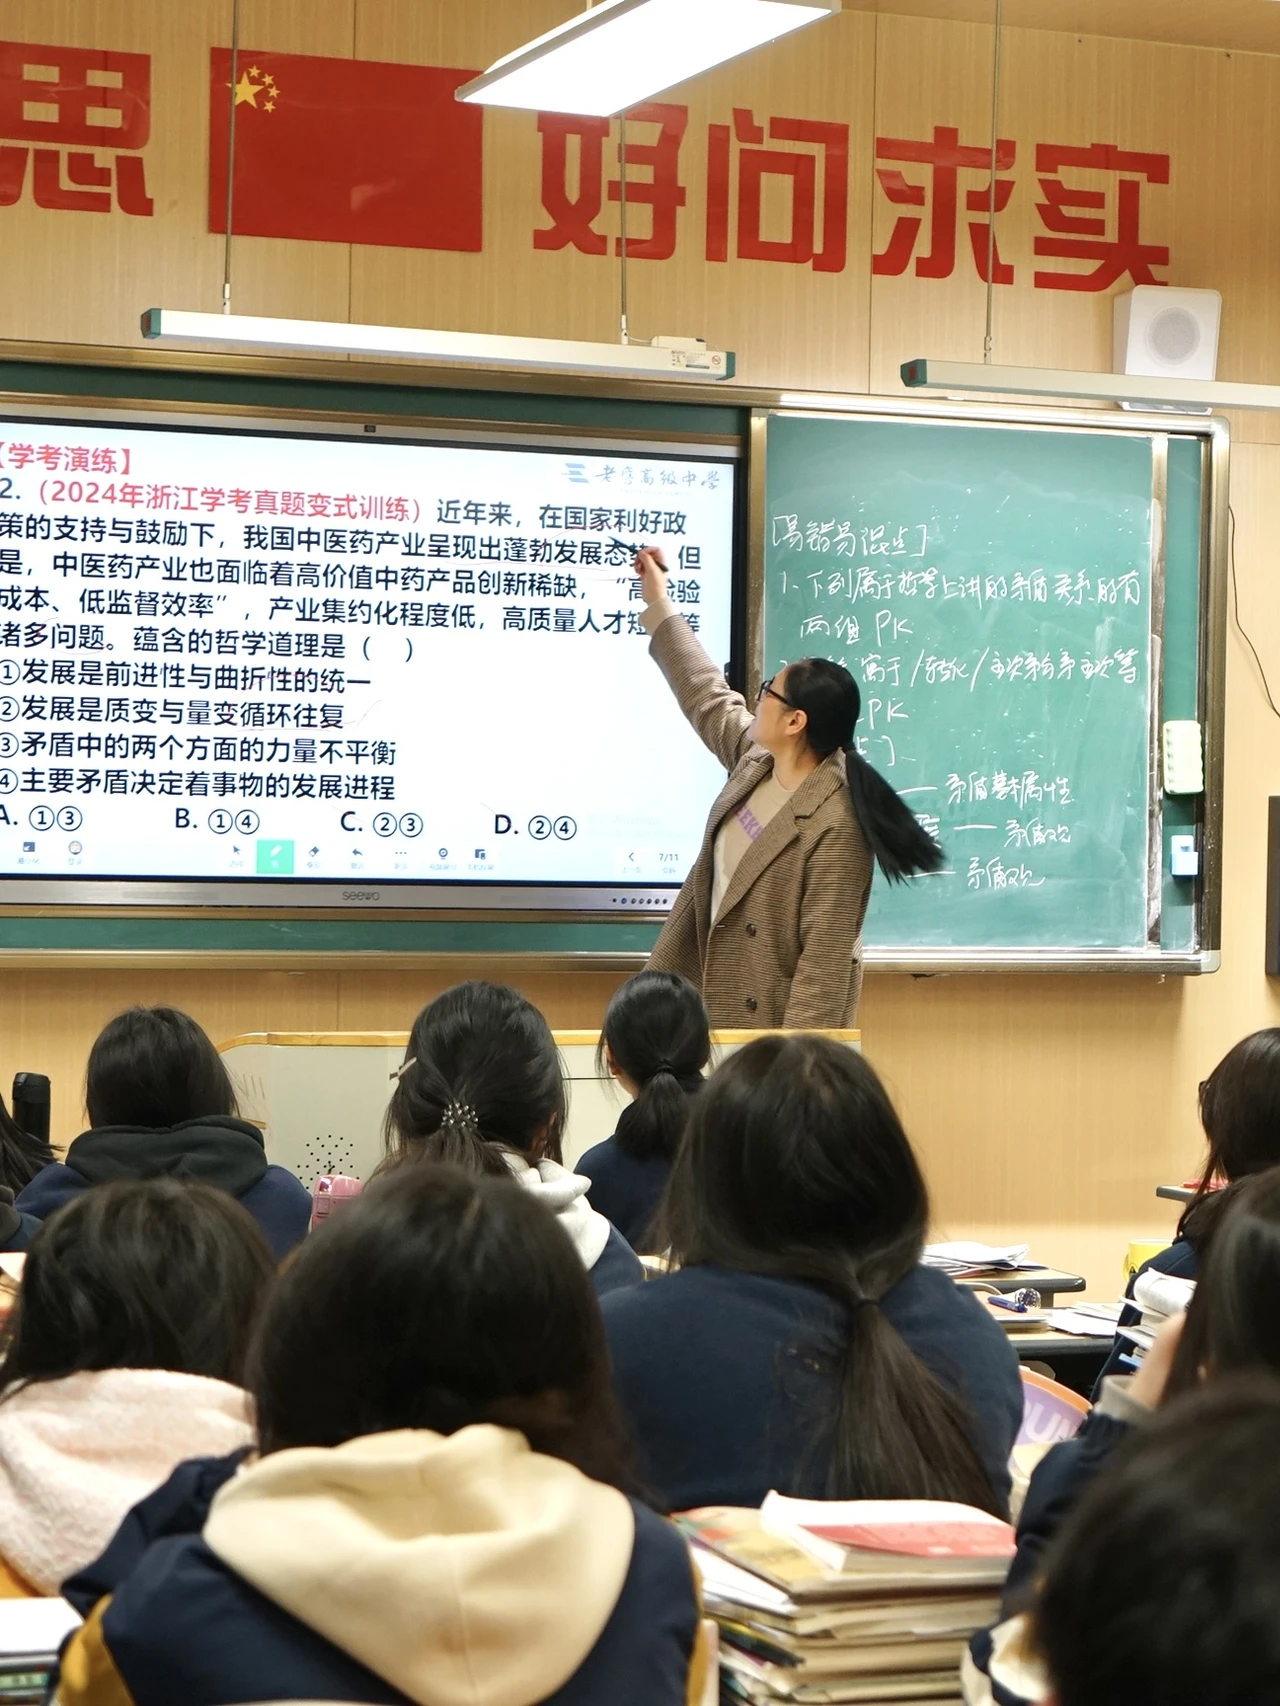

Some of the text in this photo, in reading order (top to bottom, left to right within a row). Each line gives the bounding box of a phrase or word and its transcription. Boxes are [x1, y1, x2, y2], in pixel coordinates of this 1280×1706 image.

[0, 40, 1170, 294] 思 好问求实
[800, 609, 914, 647] 两组 PK
[0, 658, 371, 694] ①发展是前进性与曲折性的统一
[0, 695, 344, 730] ②发展是质变与量变循环往复
[868, 698, 909, 730] PK
[0, 731, 396, 767] ③矛盾中的两个方面的力量不平衡
[0, 767, 396, 801] ④主要矛盾决定着事物的发展进程
[28, 805, 83, 832] ①③
[174, 807, 198, 829] B.
[207, 808, 260, 835] ①④
[340, 811, 364, 833] C.
[372, 811, 424, 838] ②③
[494, 814, 519, 835] D.
[528, 815, 577, 840] ②④
[659, 853, 679, 862] 7/11
[342, 890, 380, 901] seewo
